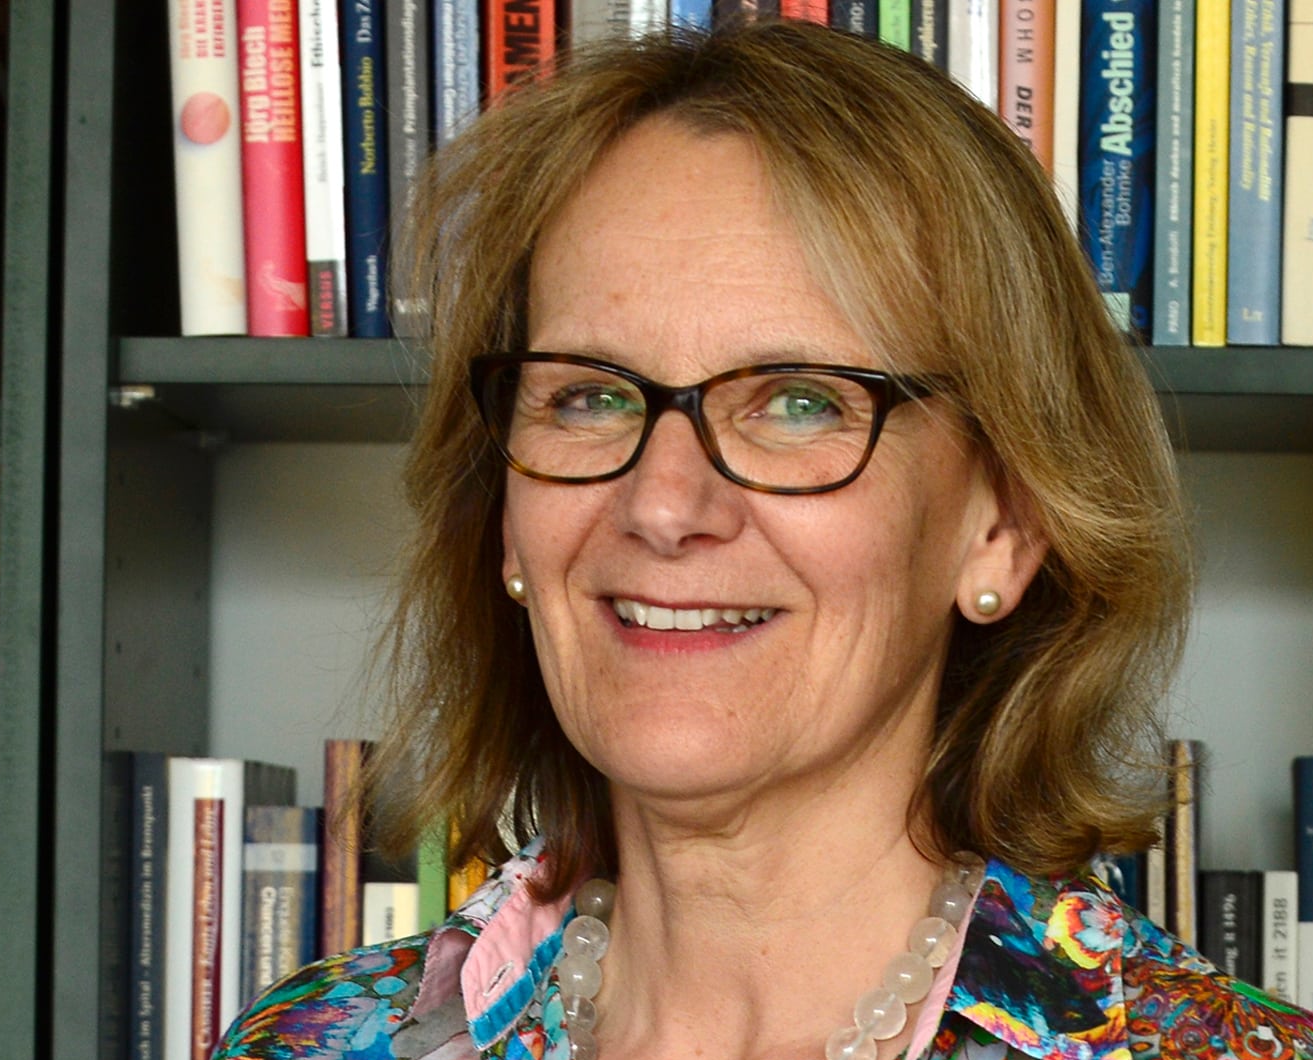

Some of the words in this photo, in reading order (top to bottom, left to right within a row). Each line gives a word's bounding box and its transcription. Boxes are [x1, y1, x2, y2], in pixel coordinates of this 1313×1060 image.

[355, 16, 371, 43] Das
[241, 25, 267, 92] Blech
[357, 56, 376, 108] Bobbio
[270, 46, 297, 143] HEILLOSE
[1016, 86, 1034, 129] DER
[1100, 12, 1135, 157] Abschied
[245, 95, 271, 143] Jörg
[1260, 98, 1274, 124] und
[361, 111, 379, 175] Norberto
[1115, 159, 1133, 226] Bohnke
[1099, 159, 1116, 285] Ben-Alexander
[319, 268, 336, 328] VERSUS
[141, 786, 156, 857] Brennpunkt
[141, 861, 153, 878] im
[197, 850, 214, 879] und
[140, 880, 154, 967] Altersmedizin
[1221, 893, 1237, 928] 1496
[1271, 897, 1289, 940] 2188
[1270, 947, 1285, 961] it
[140, 980, 154, 1017] Spital
[139, 1020, 151, 1037] im
